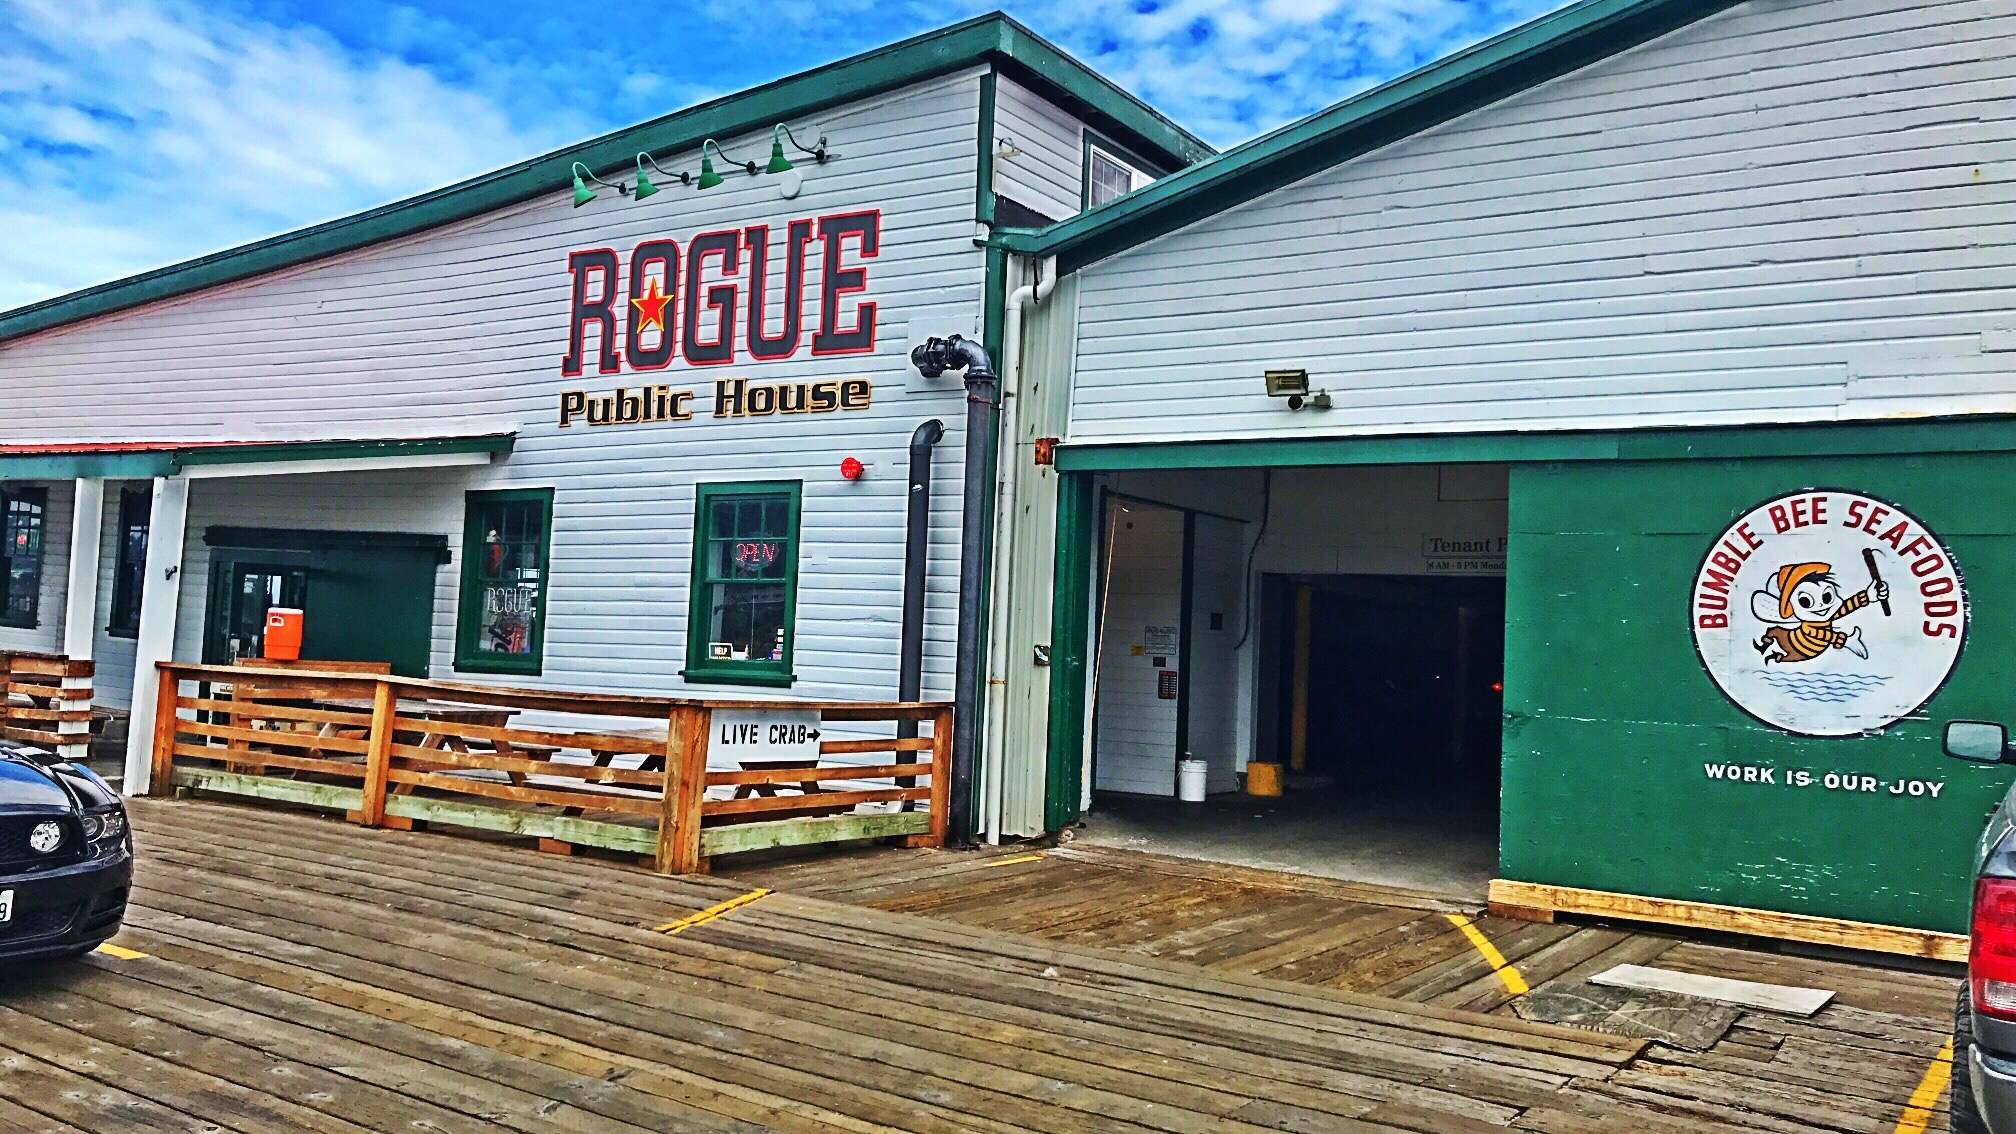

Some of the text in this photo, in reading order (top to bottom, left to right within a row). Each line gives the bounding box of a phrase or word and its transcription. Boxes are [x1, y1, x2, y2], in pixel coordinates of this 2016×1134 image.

[562, 209, 880, 377] ROGUE
[559, 375, 872, 428] Public House
[1430, 537, 1491, 553] Tenant
[1699, 497, 1958, 639] BUMBLE BEE SEAFOODS
[487, 587, 533, 613] ROGUE
[721, 723, 807, 745] LIVE CRAB
[1704, 762, 1945, 798] WORK IS OUR JOY
